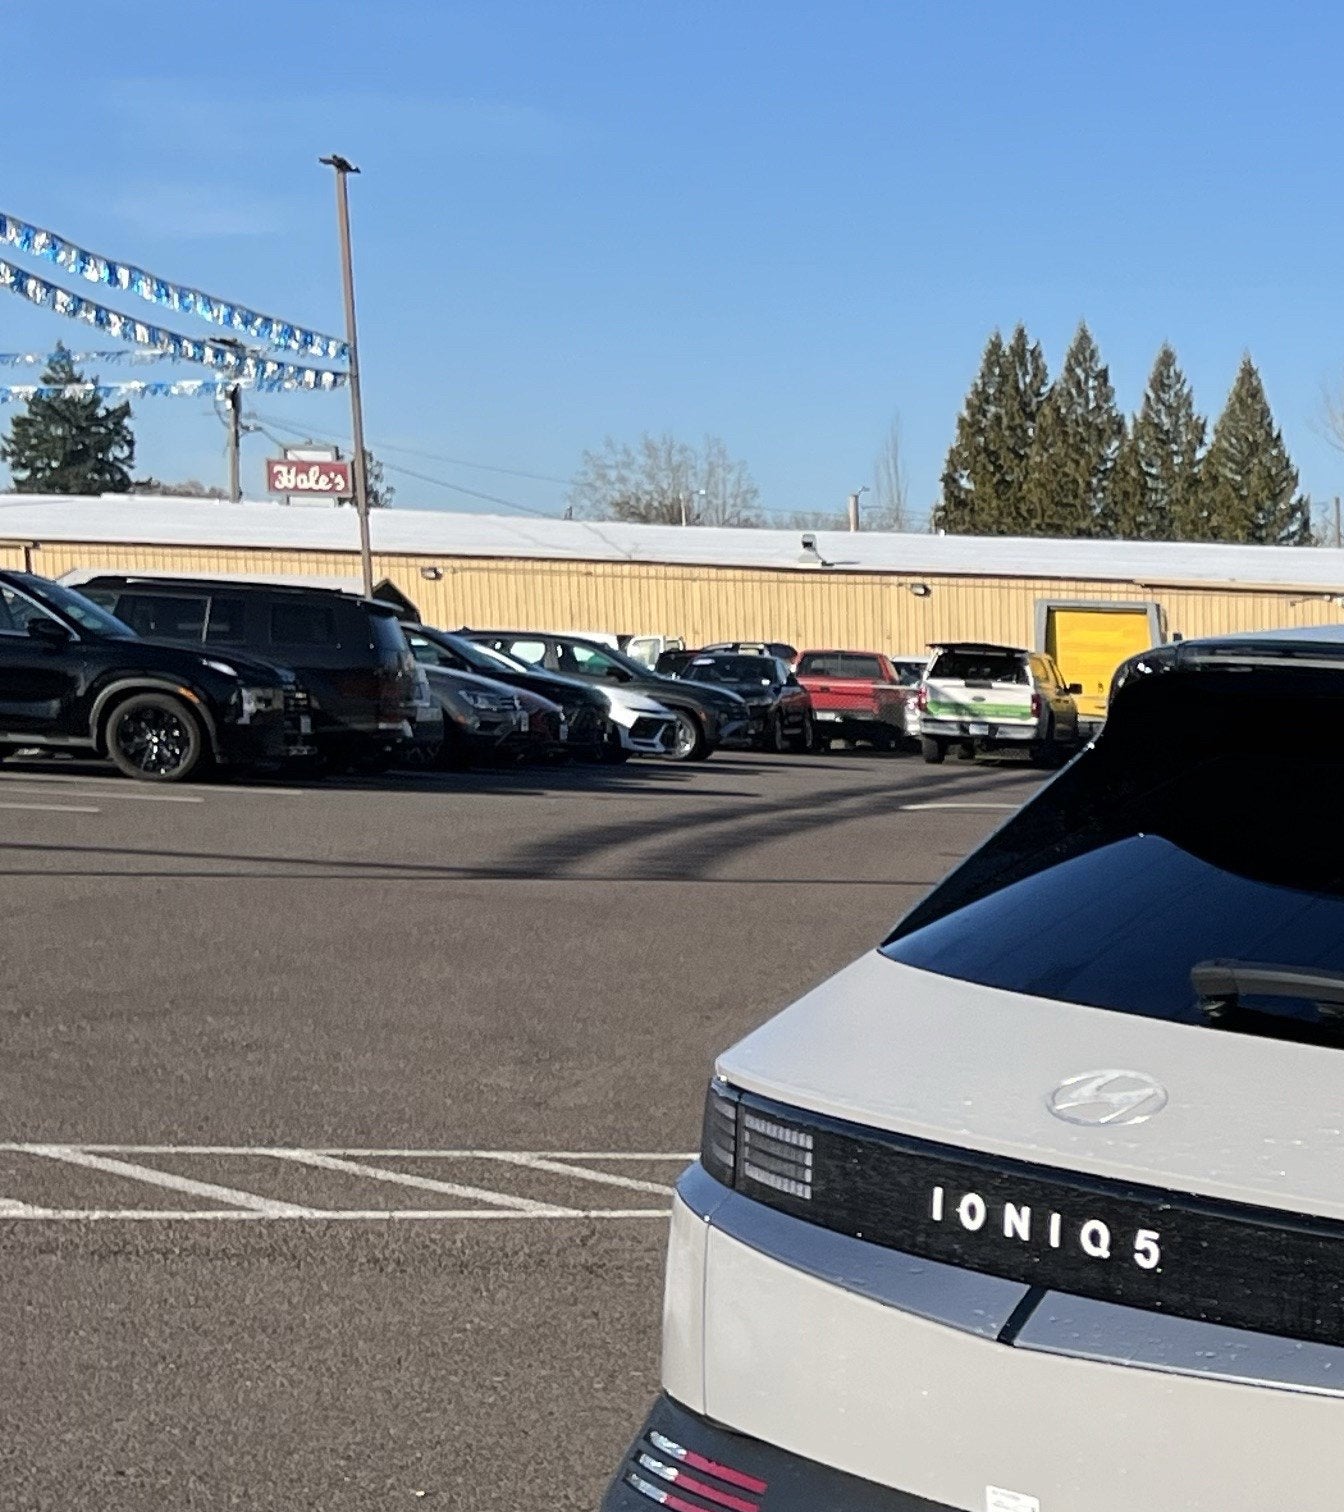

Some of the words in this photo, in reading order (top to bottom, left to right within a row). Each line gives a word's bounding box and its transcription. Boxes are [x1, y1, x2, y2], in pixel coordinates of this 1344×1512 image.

[273, 465, 345, 491] Hale's
[931, 1186, 1111, 1259] IONIQ
[1133, 1228, 1160, 1270] 5
